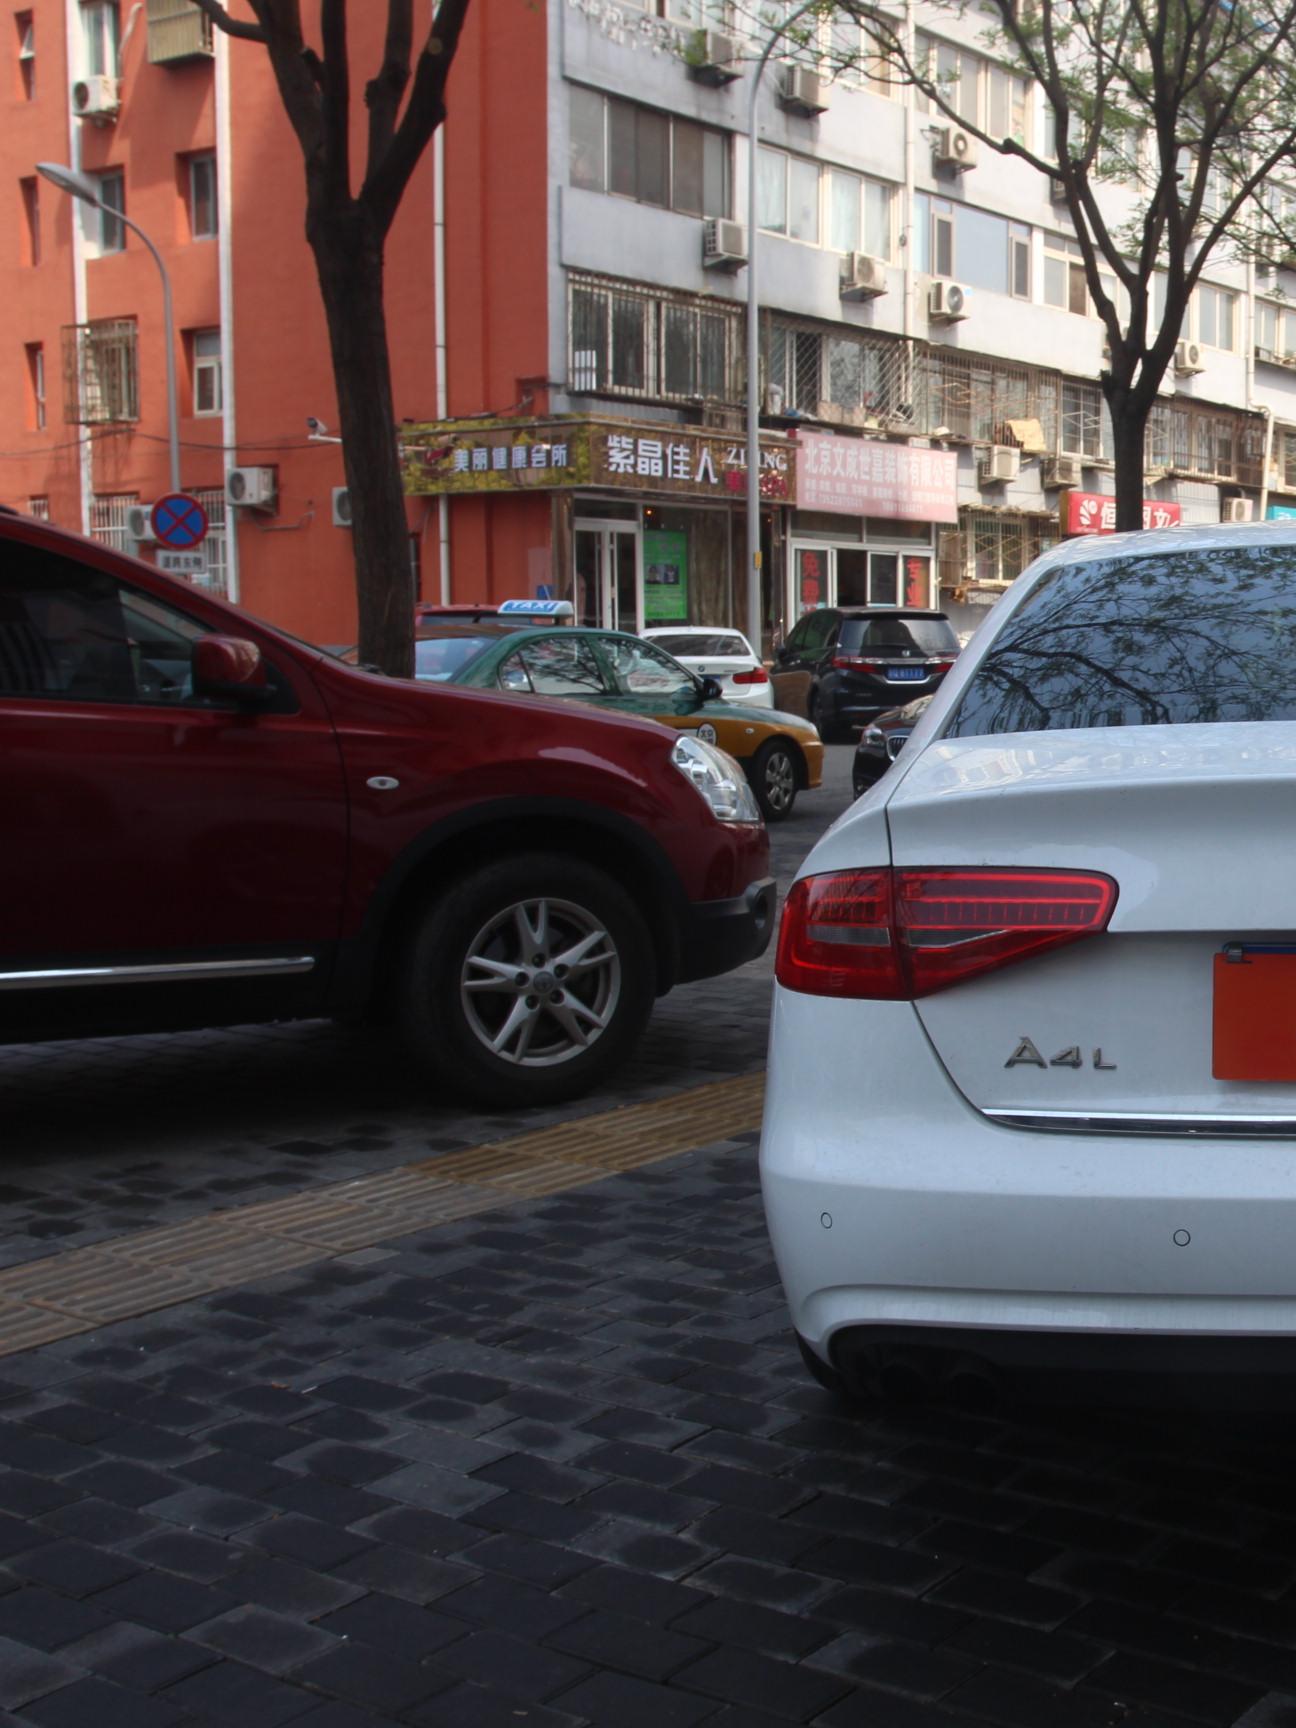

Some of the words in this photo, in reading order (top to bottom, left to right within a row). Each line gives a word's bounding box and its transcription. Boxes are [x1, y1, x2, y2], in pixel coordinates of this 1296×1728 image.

[454, 444, 567, 472] 美丽健康会所
[608, 434, 718, 483] 紫晶佳人
[805, 439, 955, 490] 北京文成世嘉装饰有限公司
[511, 601, 556, 609] TAXI
